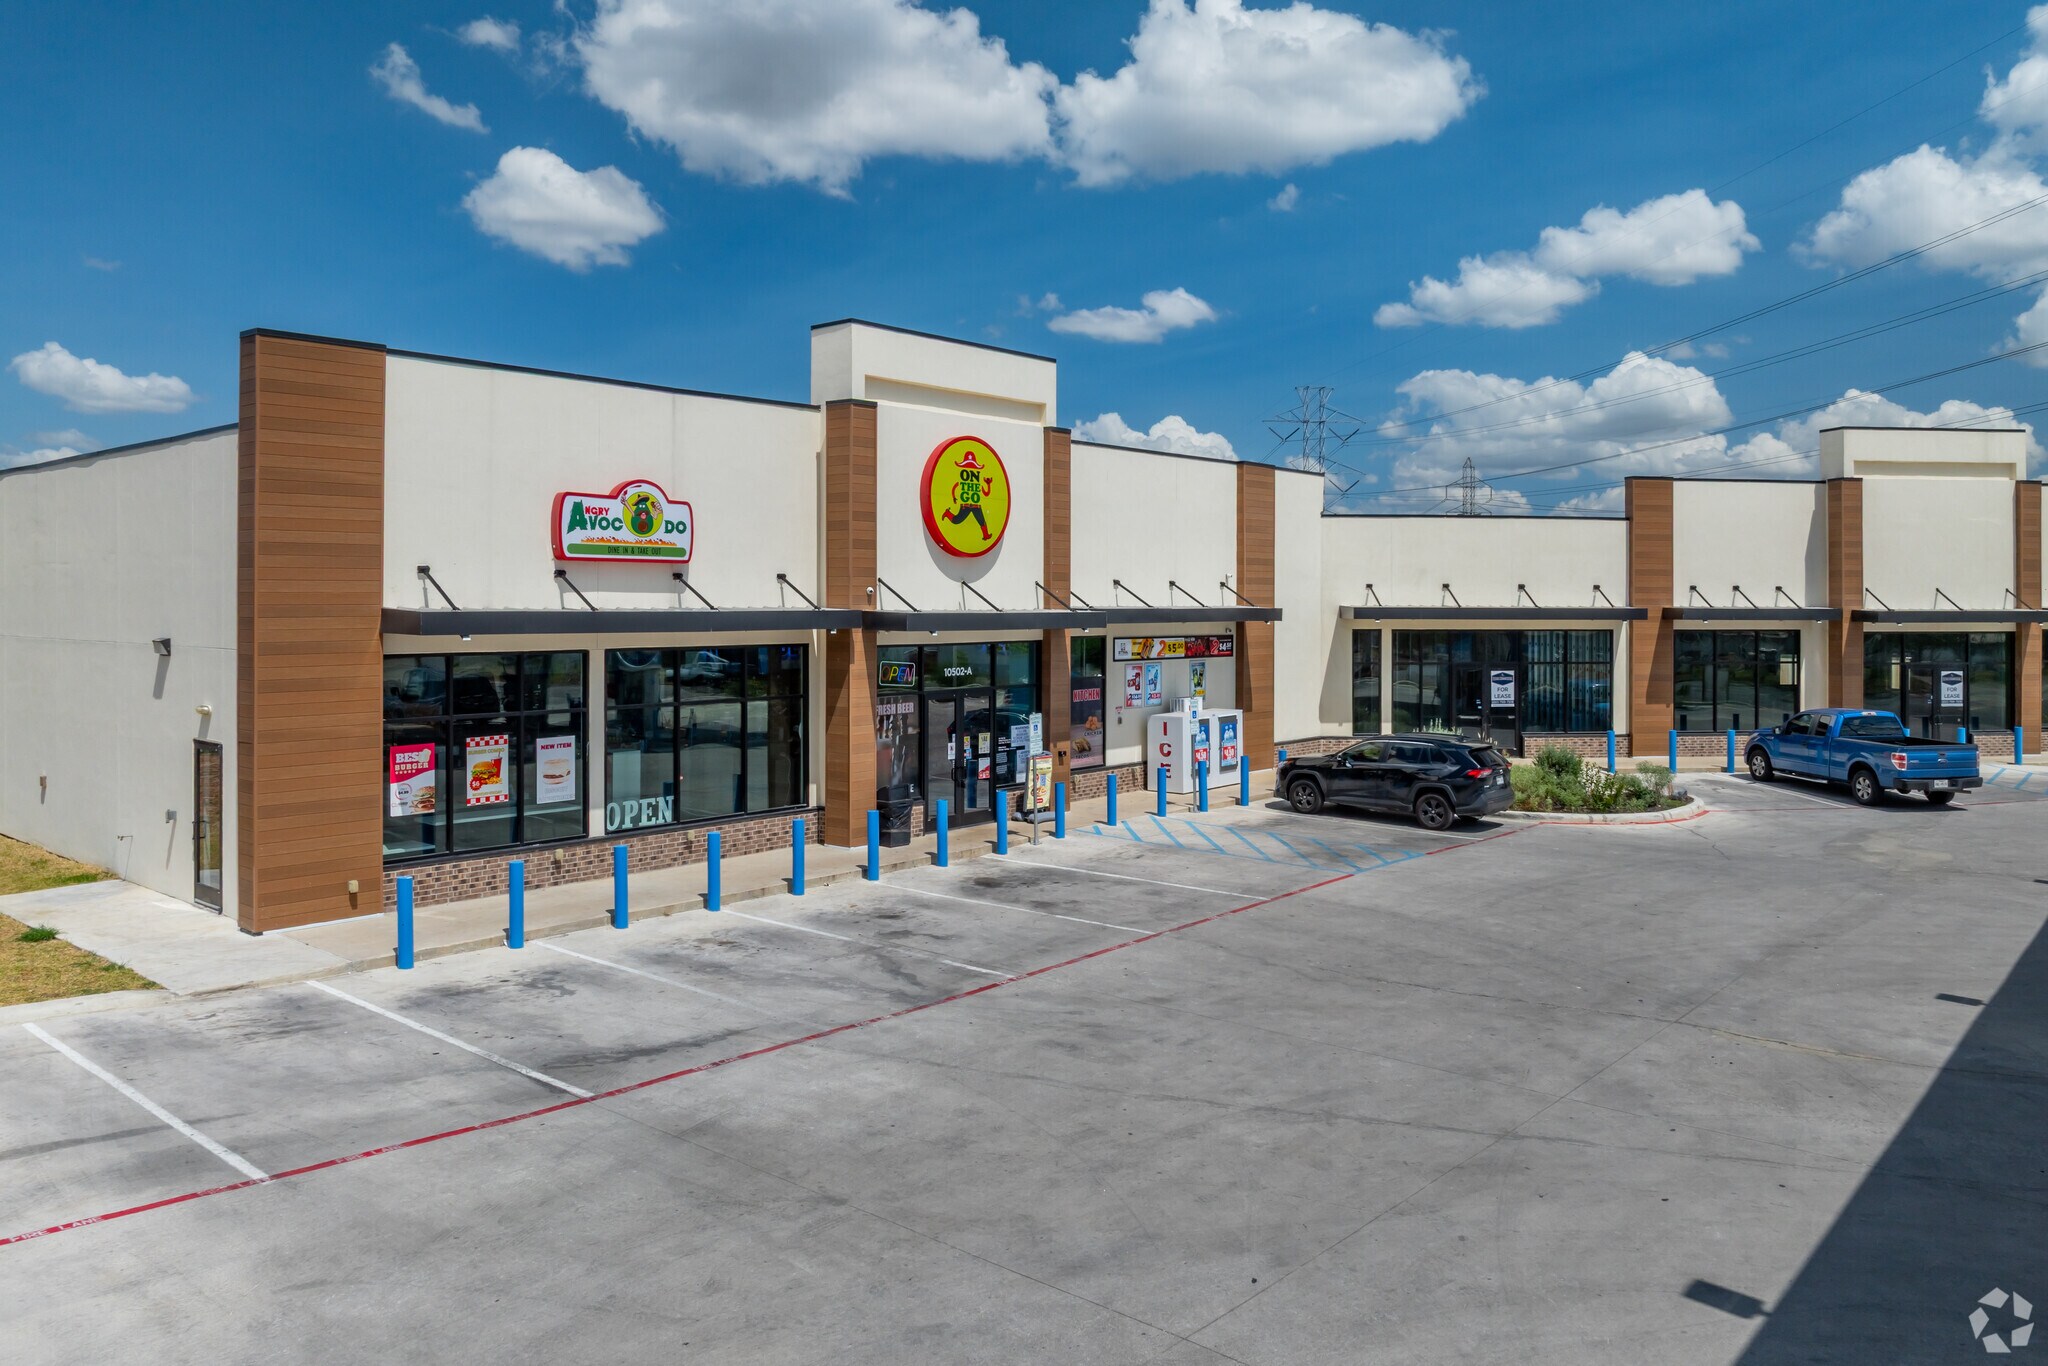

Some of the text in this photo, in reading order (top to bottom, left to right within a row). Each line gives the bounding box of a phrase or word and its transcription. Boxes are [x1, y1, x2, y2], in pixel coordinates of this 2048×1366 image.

[960, 469, 980, 482] ON
[960, 482, 981, 492] THE
[960, 492, 981, 503] GO
[608, 546, 620, 554] DINE
[637, 547, 649, 555] TAKE
[1157, 639, 1167, 657] 2
[1210, 639, 1219, 655] 2
[881, 665, 914, 683] OPEN
[943, 666, 973, 677] 10502-A
[1073, 687, 1101, 702] KITCHEN
[896, 702, 914, 714] BEER
[394, 762, 429, 771] BURGER
[606, 795, 675, 832] OPEN
[58, 1216, 105, 1232] LANE
